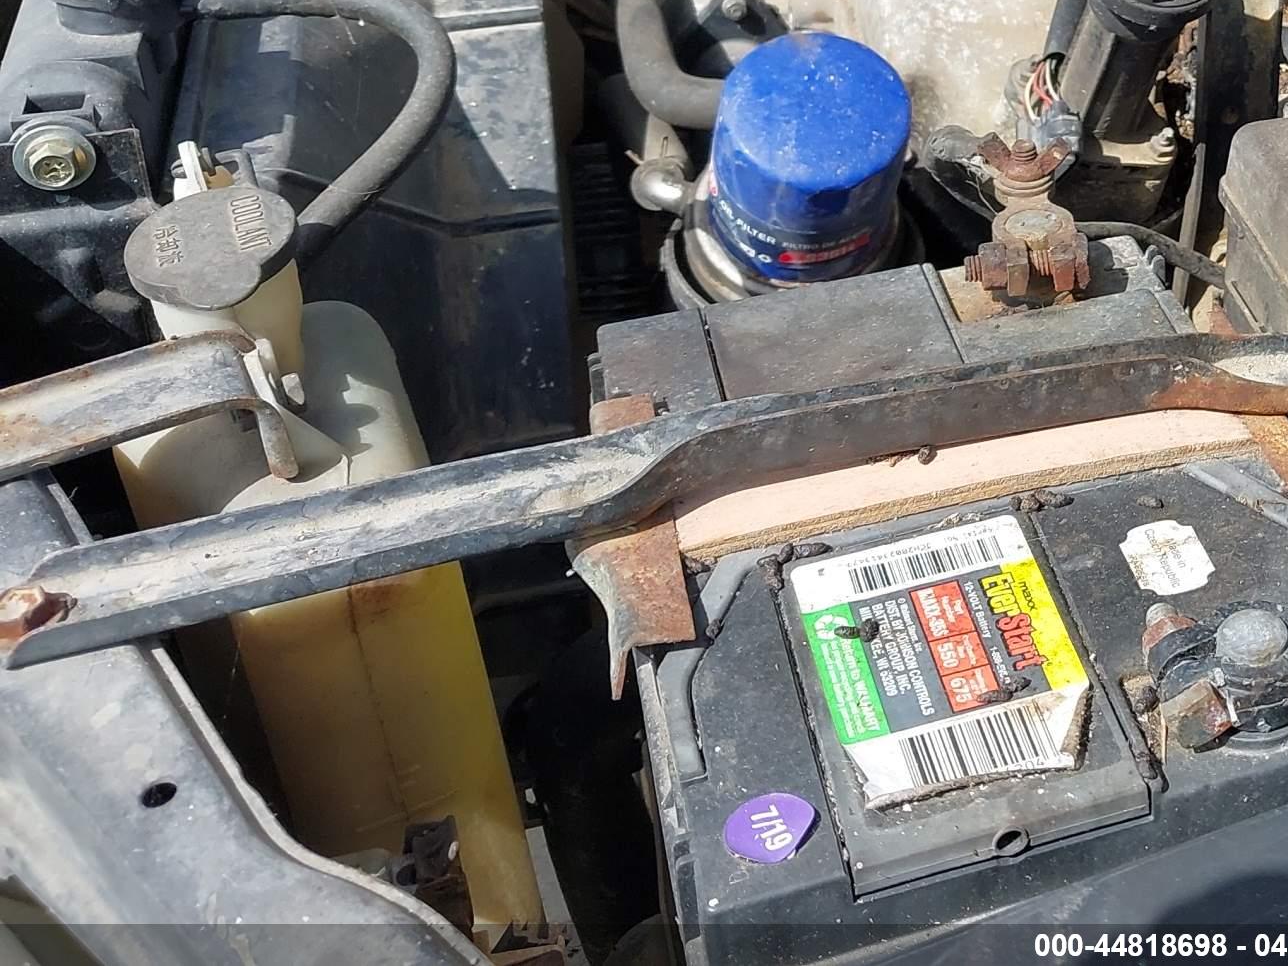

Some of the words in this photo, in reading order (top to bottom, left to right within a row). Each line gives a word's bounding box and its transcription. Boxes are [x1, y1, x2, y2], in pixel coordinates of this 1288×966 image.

[230, 195, 272, 252] COOLANT
[735, 217, 777, 245] FILTER
[1159, 554, 1181, 588] Republic
[1167, 538, 1182, 560] Made
[1177, 560, 1187, 569] in
[884, 600, 900, 621] DIST.
[963, 581, 983, 611] 12-VOLT
[975, 610, 992, 638] Battery
[1018, 580, 1038, 611] maxx
[859, 606, 885, 659] MILKEE,
[875, 658, 891, 671] WI
[891, 621, 905, 632] BY
[979, 572, 1049, 671] EverStart
[872, 603, 894, 641] BATTERY
[895, 674, 912, 695] INC.
[895, 632, 918, 670] JOHNSON
[937, 640, 960, 669] 550
[853, 680, 881, 731] WALMART
[908, 669, 935, 716] CONTROLS
[950, 677, 973, 703] 675
[750, 804, 793, 851] 7/19
